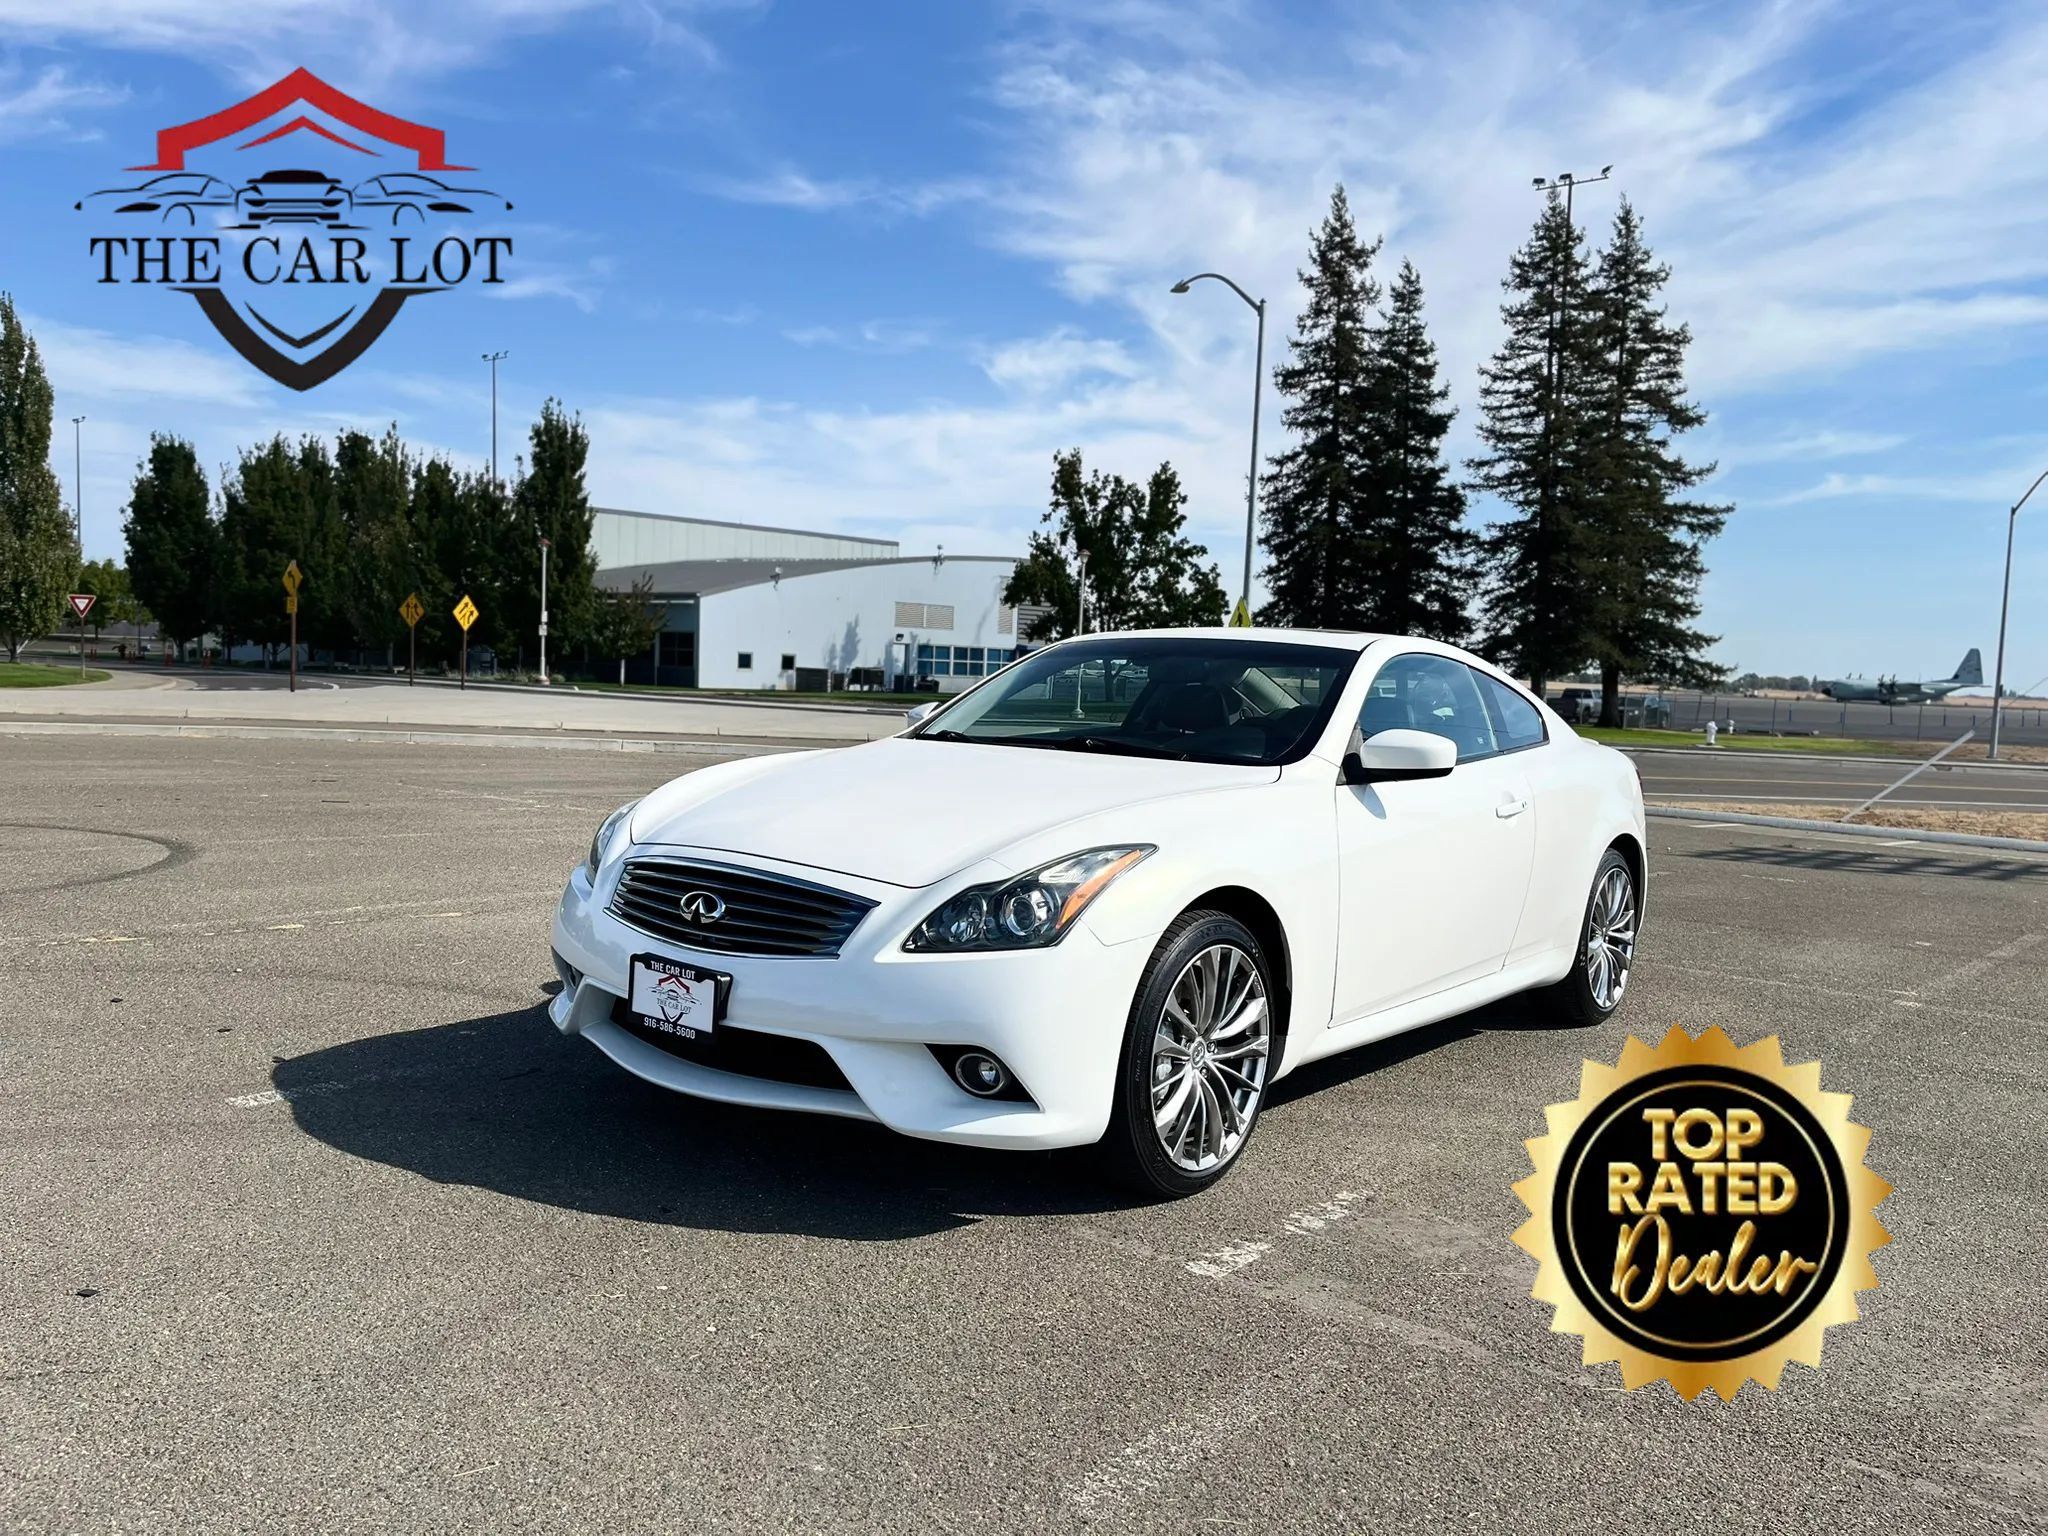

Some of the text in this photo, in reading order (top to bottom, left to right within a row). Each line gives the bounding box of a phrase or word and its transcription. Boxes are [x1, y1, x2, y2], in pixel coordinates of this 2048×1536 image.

[651, 960, 695, 980] THE CAR LOT
[657, 998, 692, 1013] THE CAR LOT
[644, 1016, 696, 1040] 916-586-5600
